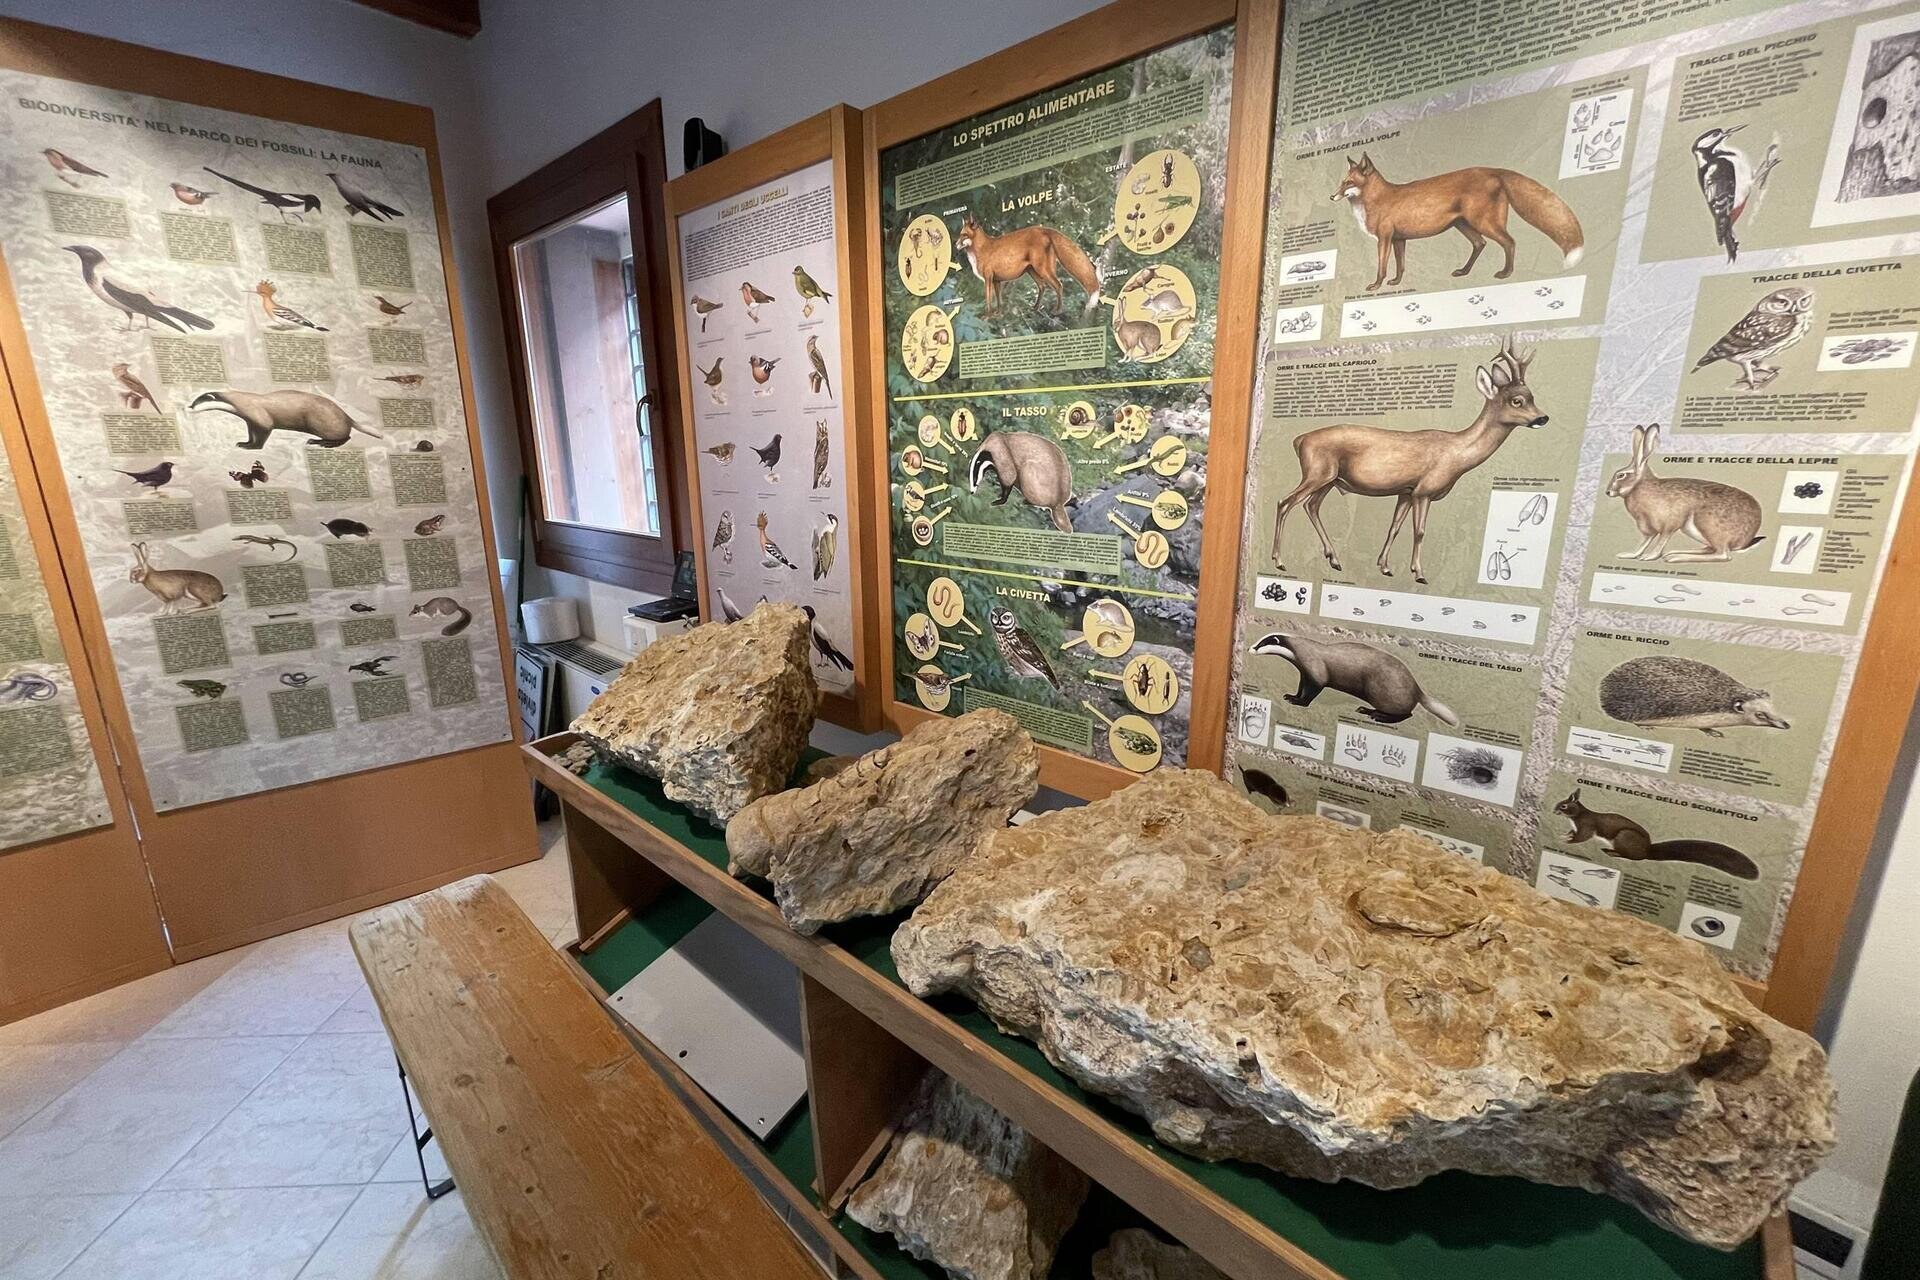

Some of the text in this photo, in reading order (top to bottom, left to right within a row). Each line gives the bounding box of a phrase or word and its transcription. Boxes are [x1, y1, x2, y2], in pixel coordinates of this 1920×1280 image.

[1690, 33, 1817, 69] TRACCE DEL PICCHIO
[953, 79, 1116, 147] LO SPETTRO ALIMENTARE
[145, 119, 175, 135] NEL
[180, 126, 230, 144] PARCO
[235, 135, 258, 149] DEI
[262, 141, 317, 159] FOSSILI:
[321, 150, 337, 163] LA
[340, 154, 383, 170] FAUNA
[1296, 151, 1315, 160] ORME
[1323, 142, 1350, 154] TRACCE
[1352, 137, 1374, 148] DELLA
[1376, 131, 1400, 141] VOLPE
[1001, 189, 1053, 213] LA VOLPE
[1752, 262, 1902, 284] TRACCE DELLA CIVETTA
[1342, 359, 1377, 367] CAPRIOLO
[1002, 406, 1047, 418] IL TASSO
[1662, 455, 1839, 466] ORME E TRACCE DELLA LEPRE
[996, 586, 1050, 602] LA CIVETTA
[1586, 630, 1670, 646] ORME DEL RICCIO
[1418, 652, 1439, 661] ORME
[1448, 656, 1478, 667] TRACCE
[1479, 661, 1494, 669] DEL
[1496, 664, 1522, 673] TASSO
[1576, 777, 1759, 823] ORME E TRACCE DELLO SCOIATTOLO
